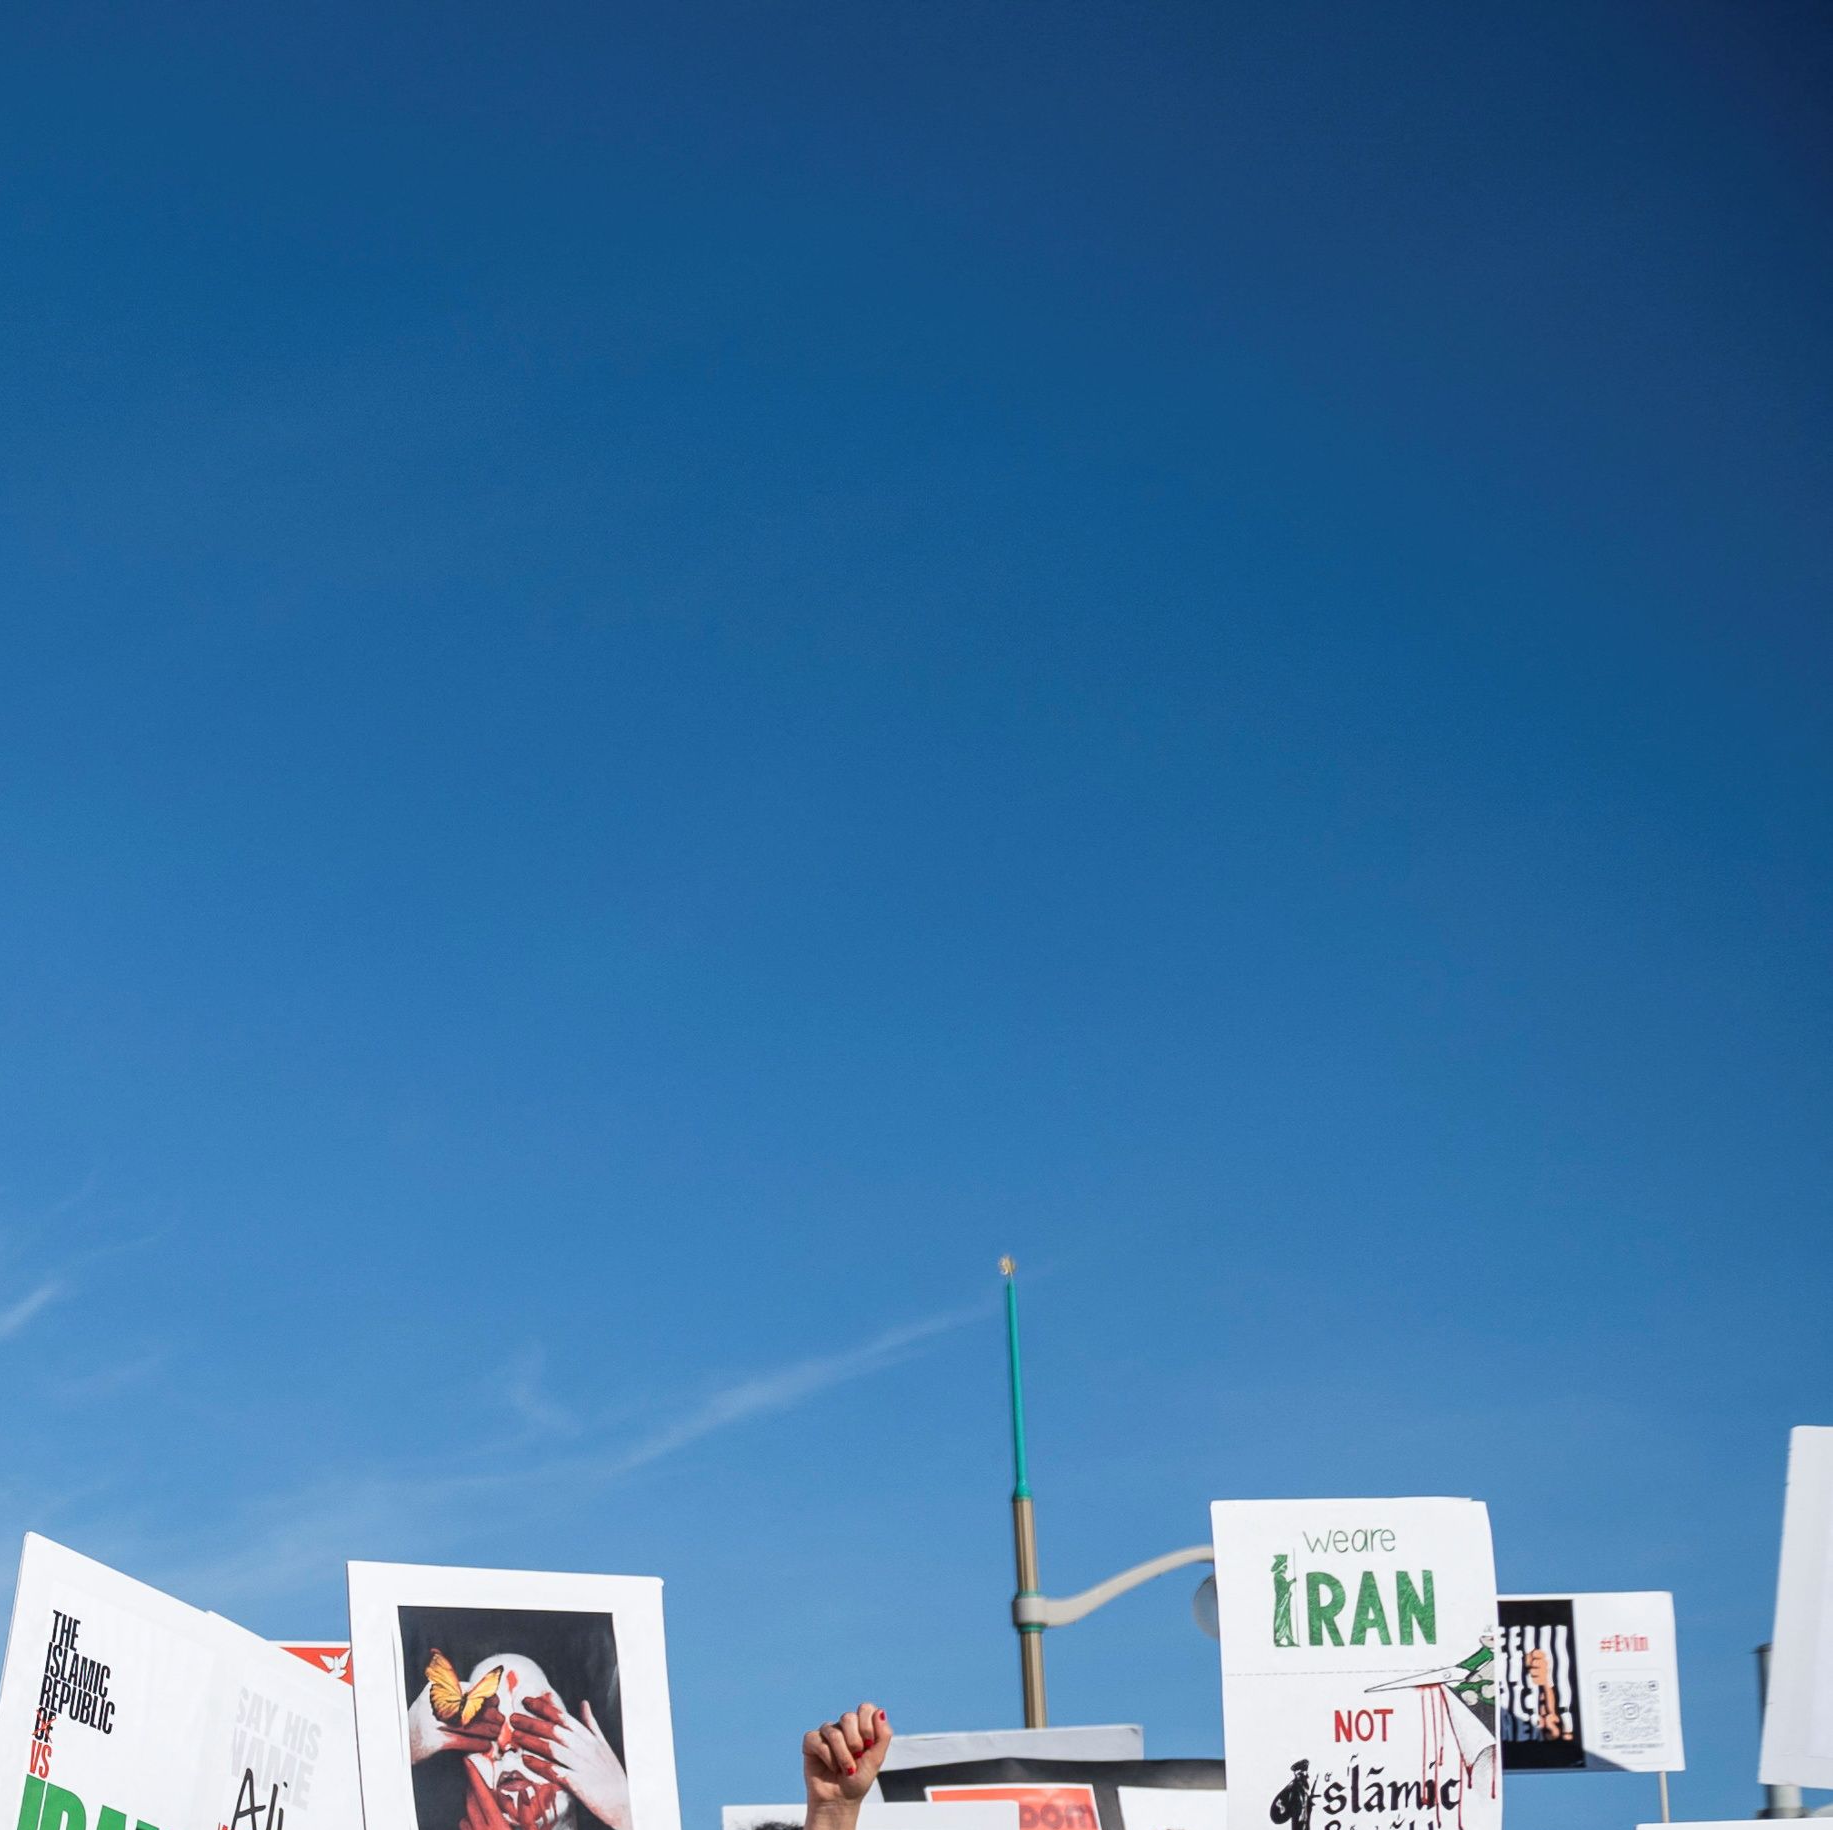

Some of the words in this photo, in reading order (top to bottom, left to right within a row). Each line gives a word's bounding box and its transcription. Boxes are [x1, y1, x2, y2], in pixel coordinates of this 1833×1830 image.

[52, 1609, 81, 1651] THE
[1598, 1633, 1650, 1653] #Evin
[44, 1642, 111, 1698] ISLAMIC
[34, 1706, 56, 1743] OF
[39, 1674, 116, 1735] REPUBLIC
[236, 1685, 279, 1738] SAY
[283, 1710, 322, 1762] HIS
[1334, 1708, 1394, 1743] NOT
[29, 1739, 52, 1779] VS
[231, 1726, 314, 1811] NAME
